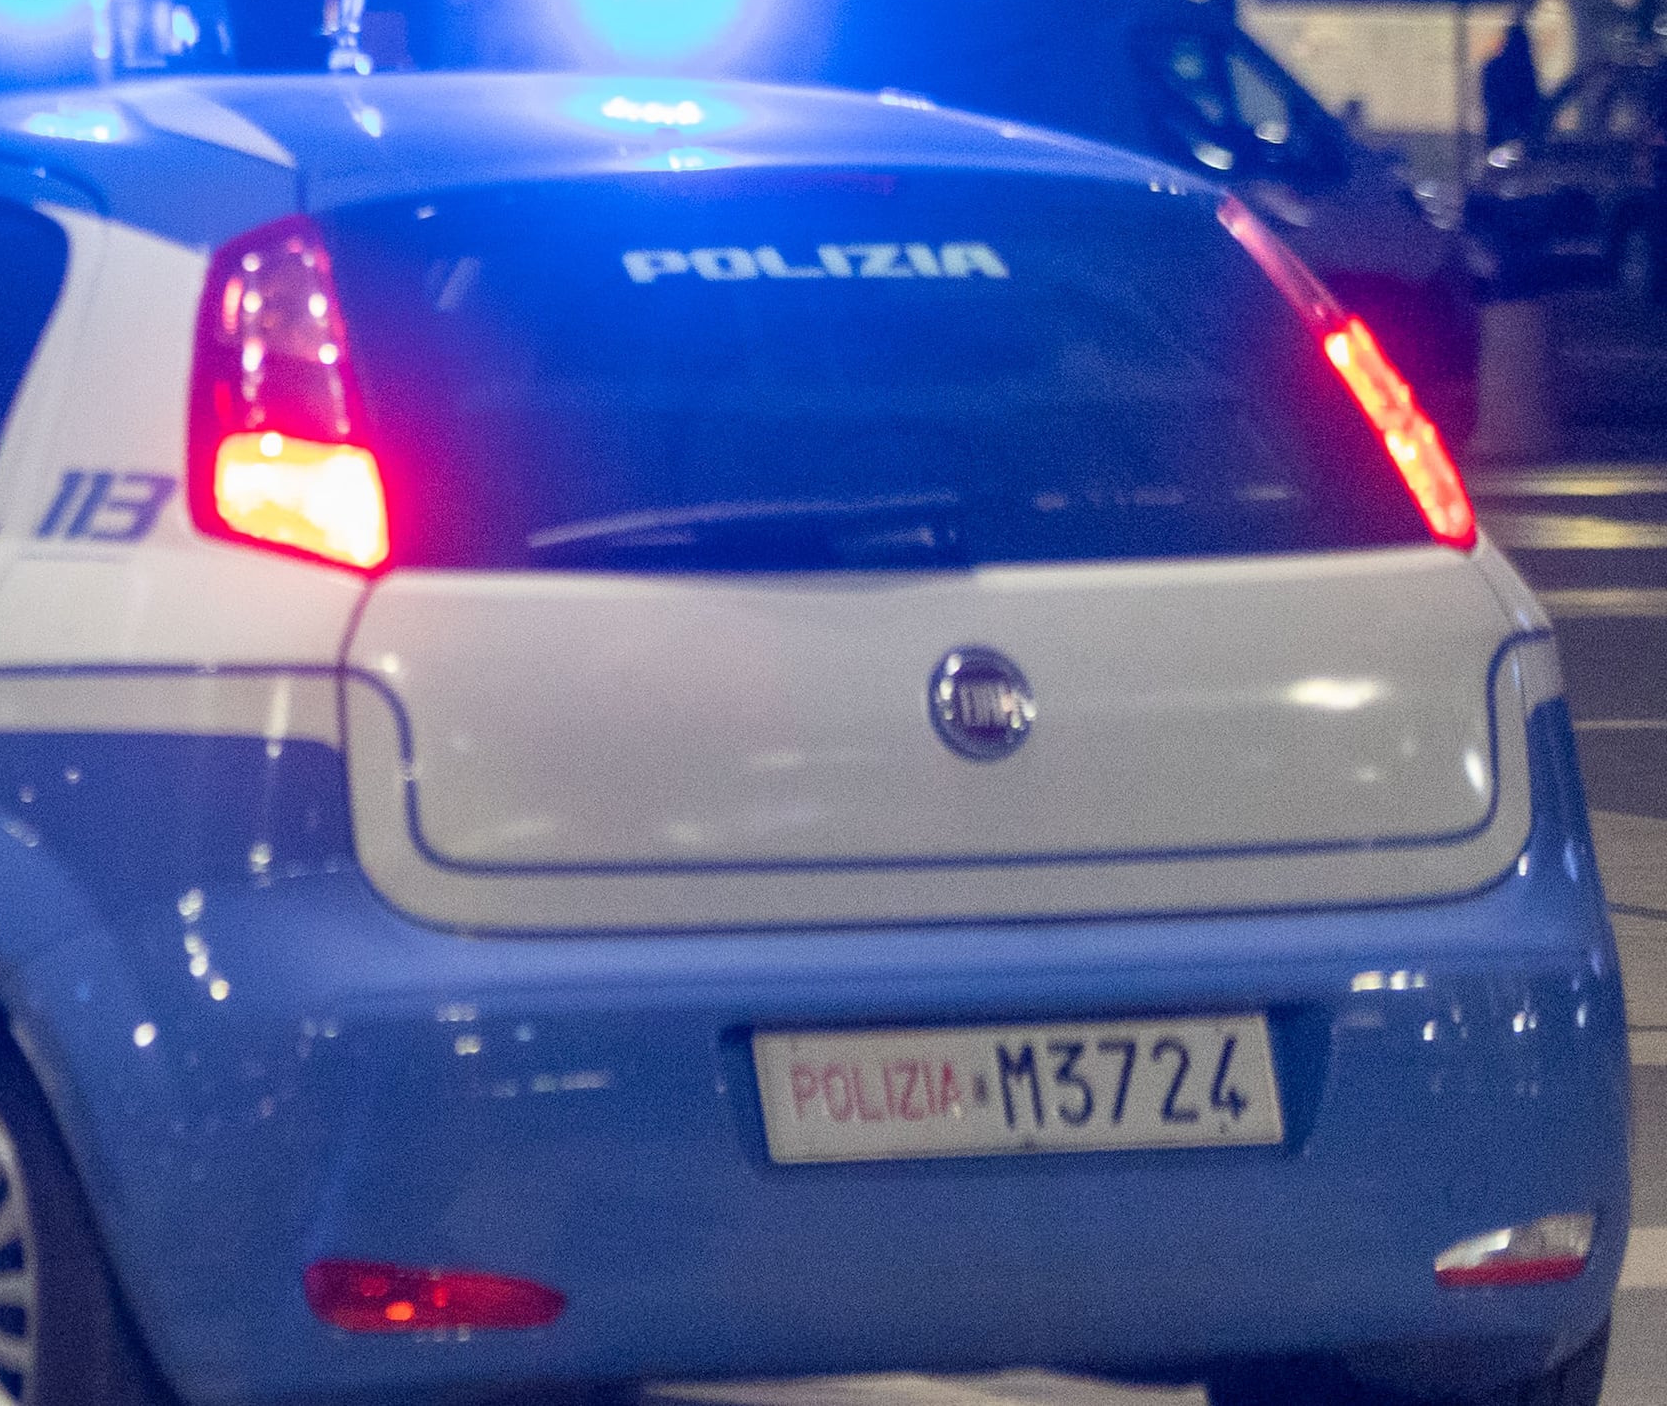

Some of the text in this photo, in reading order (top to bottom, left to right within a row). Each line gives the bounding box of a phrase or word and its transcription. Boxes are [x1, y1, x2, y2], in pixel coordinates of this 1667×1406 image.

[622, 242, 1009, 283] POLIZIA
[34, 469, 176, 544] 113
[790, 1034, 1249, 1129] POLIZIA M3724
